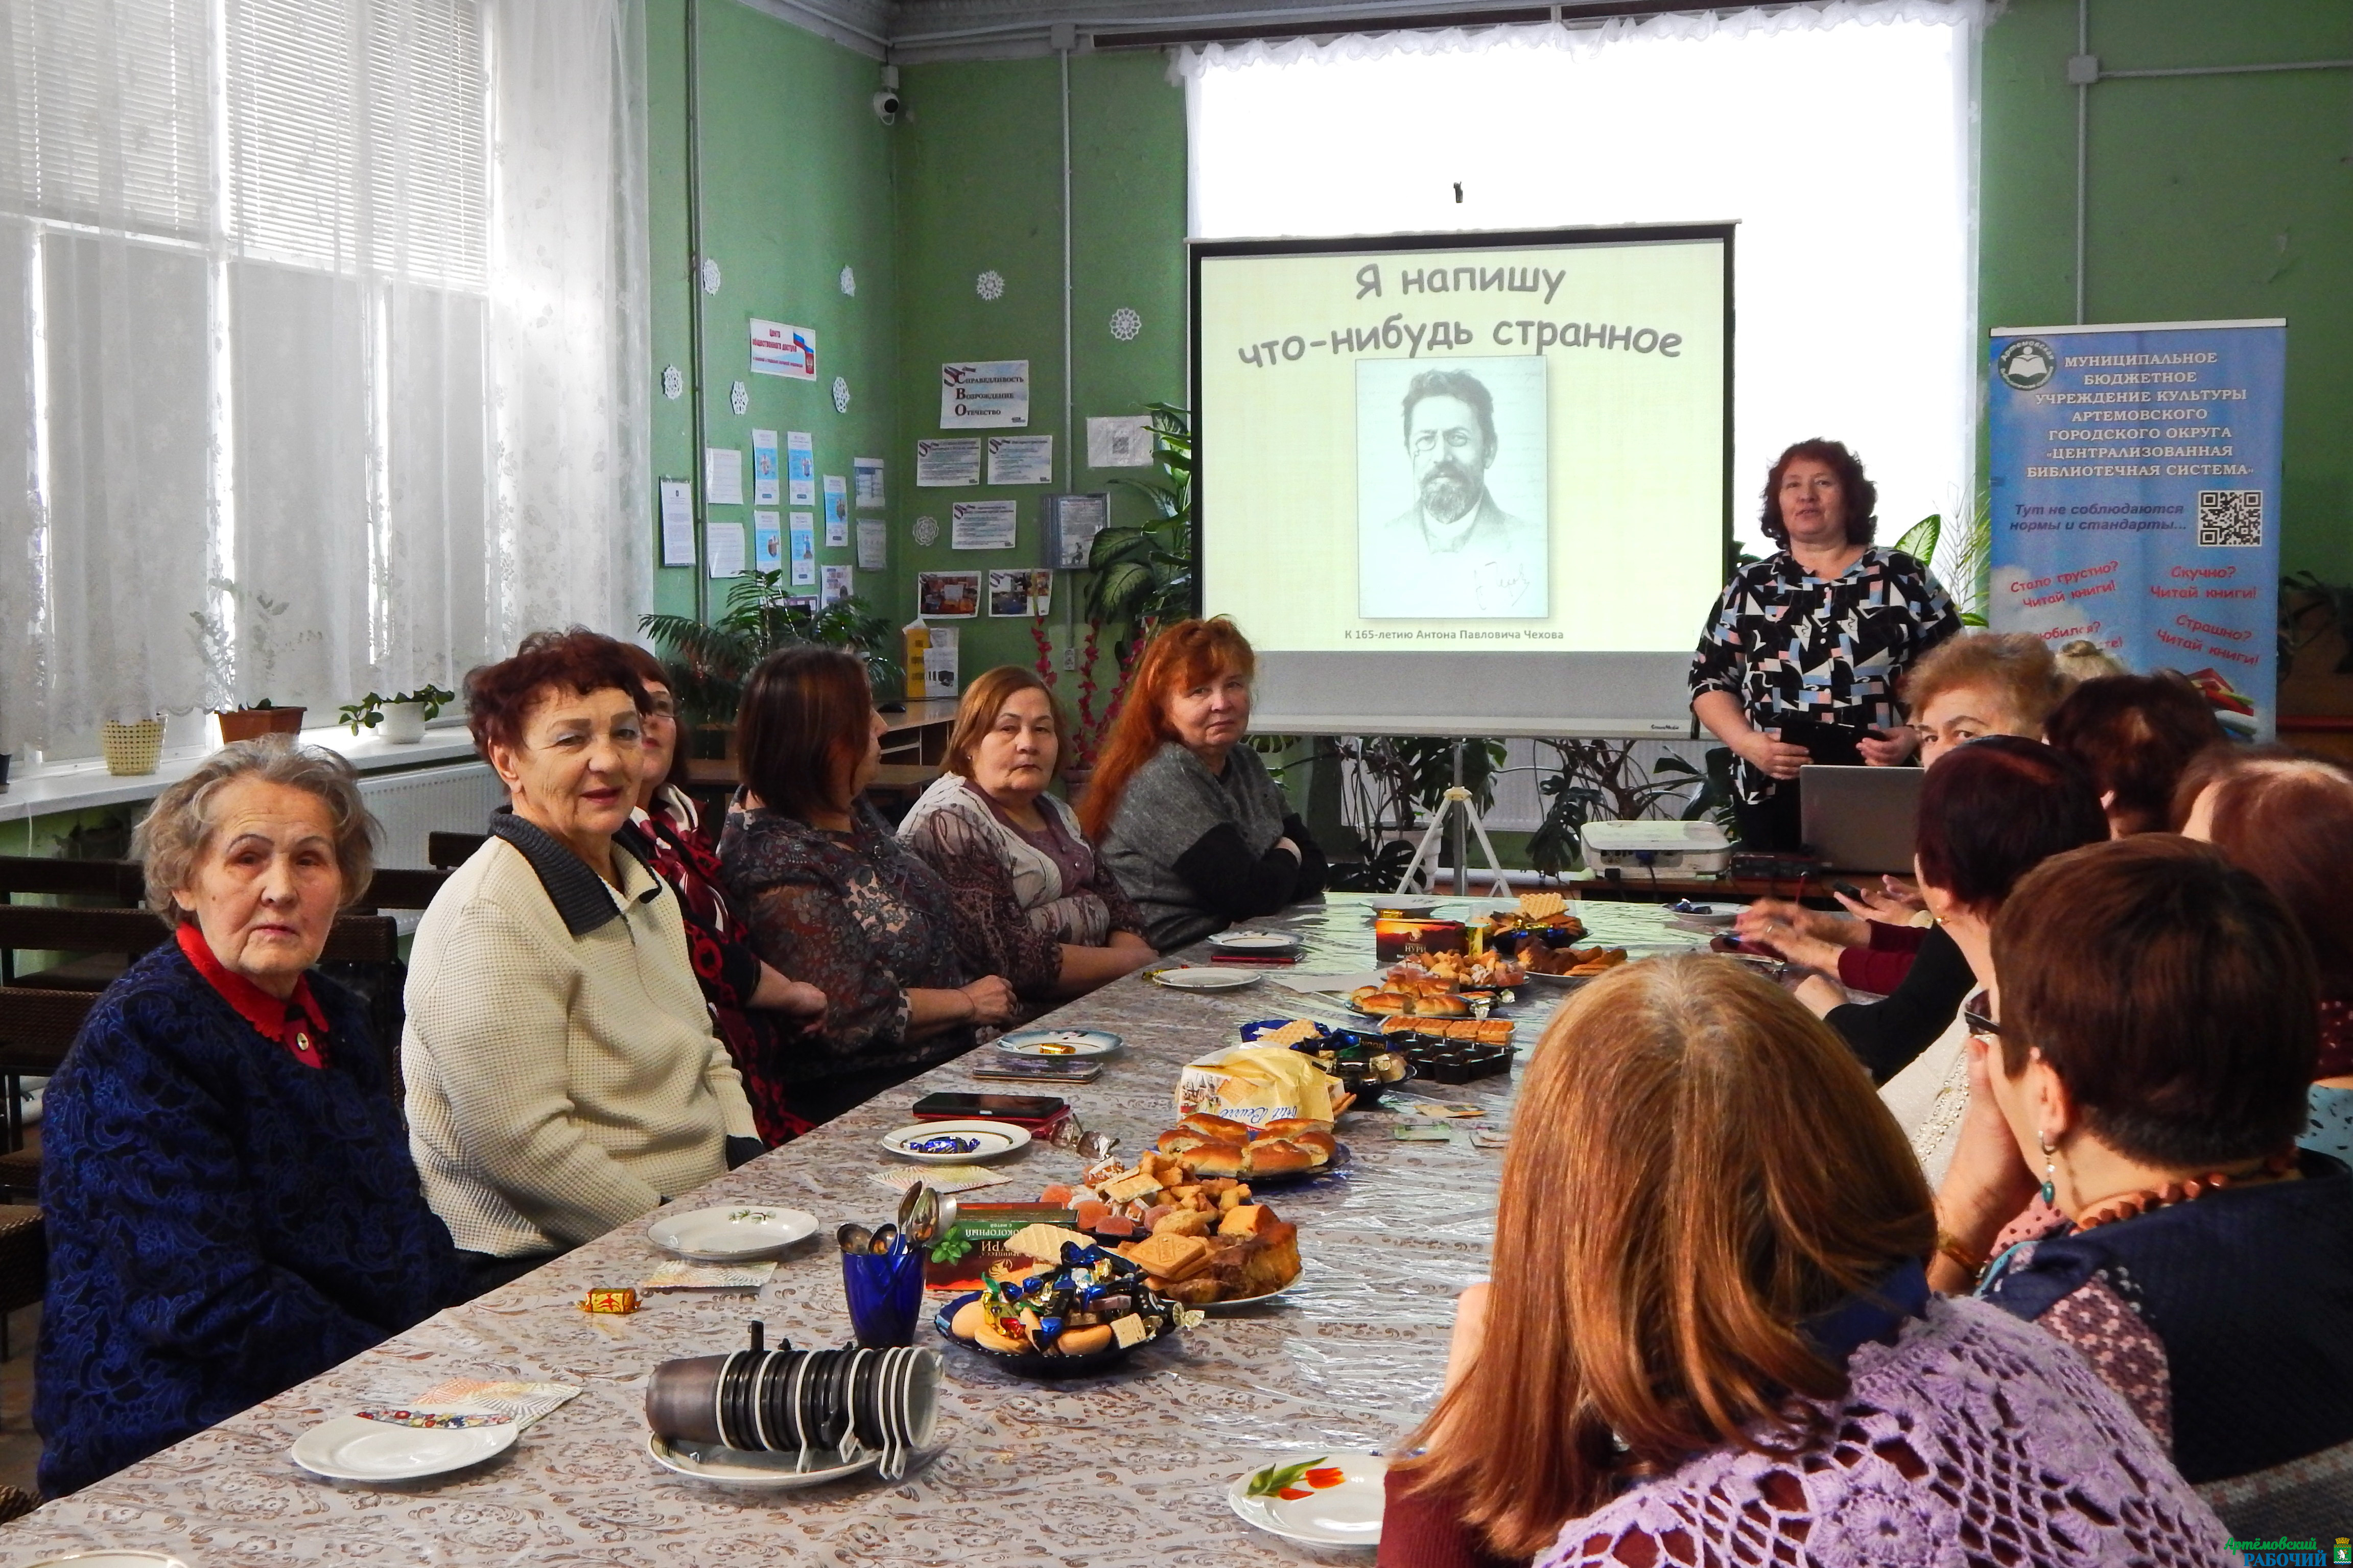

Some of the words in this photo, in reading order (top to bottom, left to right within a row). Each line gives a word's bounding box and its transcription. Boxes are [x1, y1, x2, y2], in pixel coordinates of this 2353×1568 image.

[1356, 264, 1382, 300] Я
[1402, 267, 1567, 304] напишу
[1238, 313, 1473, 369] что-нибудь
[1492, 319, 1683, 358] странное
[2065, 352, 2218, 367] МУНИЦИПАЛЬНОЕ
[2084, 372, 2197, 386] БЮДЖЕТНОЕ
[2035, 392, 2151, 405] УЧРЕЖДЕНИЕ
[2157, 389, 2247, 402] КУЛЬТУРЫ
[2072, 409, 2207, 422] АРТЕМОВСКОГО
[2049, 429, 2161, 442] ГОРОДСКОГО
[2166, 427, 2232, 439] ОКРУГА
[2046, 446, 2233, 460] «ЦЕНТРАЛИЗОВАННАЯ
[2027, 465, 2160, 478] БИБЛИОТЕЧНАЯ
[2167, 464, 2254, 476] СИСТЕМА»
[2015, 505, 2044, 517] Тут
[2049, 506, 2066, 514] не
[2071, 503, 2184, 515] соблюдаются
[2010, 521, 2061, 532] нормы
[2065, 521, 2074, 530] и
[2079, 518, 2186, 532] стандарты...
[2011, 577, 2052, 592] Стало
[2057, 560, 2119, 584] грустно?
[2171, 566, 2237, 581] Скучно?
[2023, 591, 2065, 608] Читай
[2071, 580, 2116, 599] книги!
[2150, 586, 2198, 598] Читай
[2206, 586, 2257, 598] книги!
[1355, 630, 1413, 639] 165-летию
[1417, 630, 1456, 639] Антона
[1460, 630, 1521, 639] Павловича
[1524, 630, 1564, 639] Чехова
[2176, 614, 2252, 642] Страшно?
[2157, 629, 2203, 651] Читай
[2209, 647, 2260, 666] книги!
[1218, 1107, 1269, 1124] Beurre
[981, 1241, 1007, 1251] УРИ
